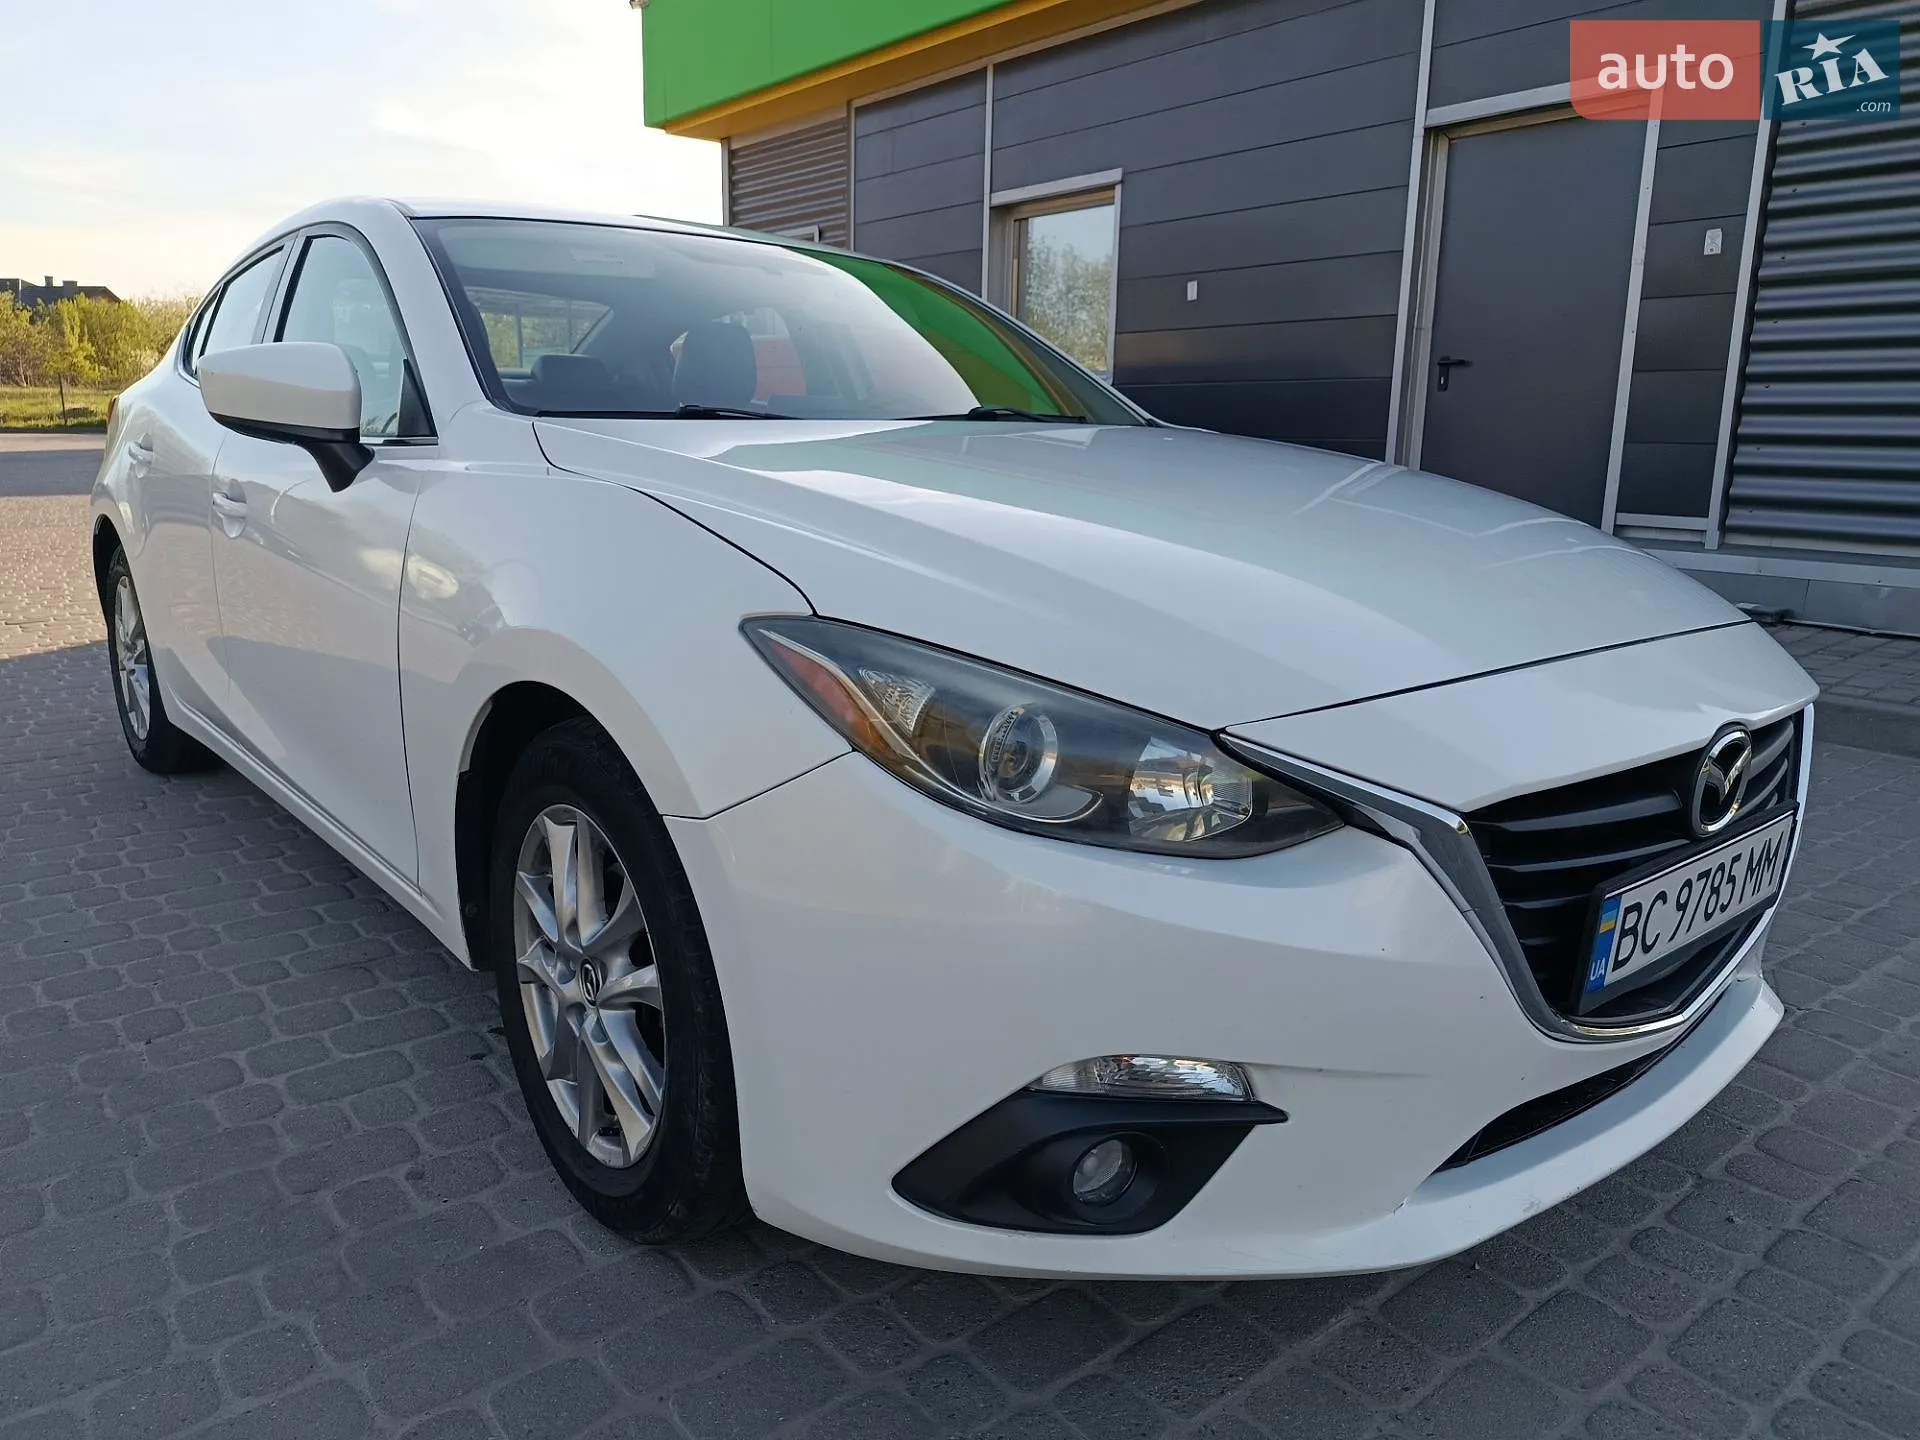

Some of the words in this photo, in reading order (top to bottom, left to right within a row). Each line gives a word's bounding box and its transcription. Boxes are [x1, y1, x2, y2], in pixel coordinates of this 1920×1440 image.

[1611, 890, 1668, 973] BC
[1667, 852, 1743, 944] 9785
[1738, 831, 1785, 905] MM
[1589, 959, 1606, 981] UA
